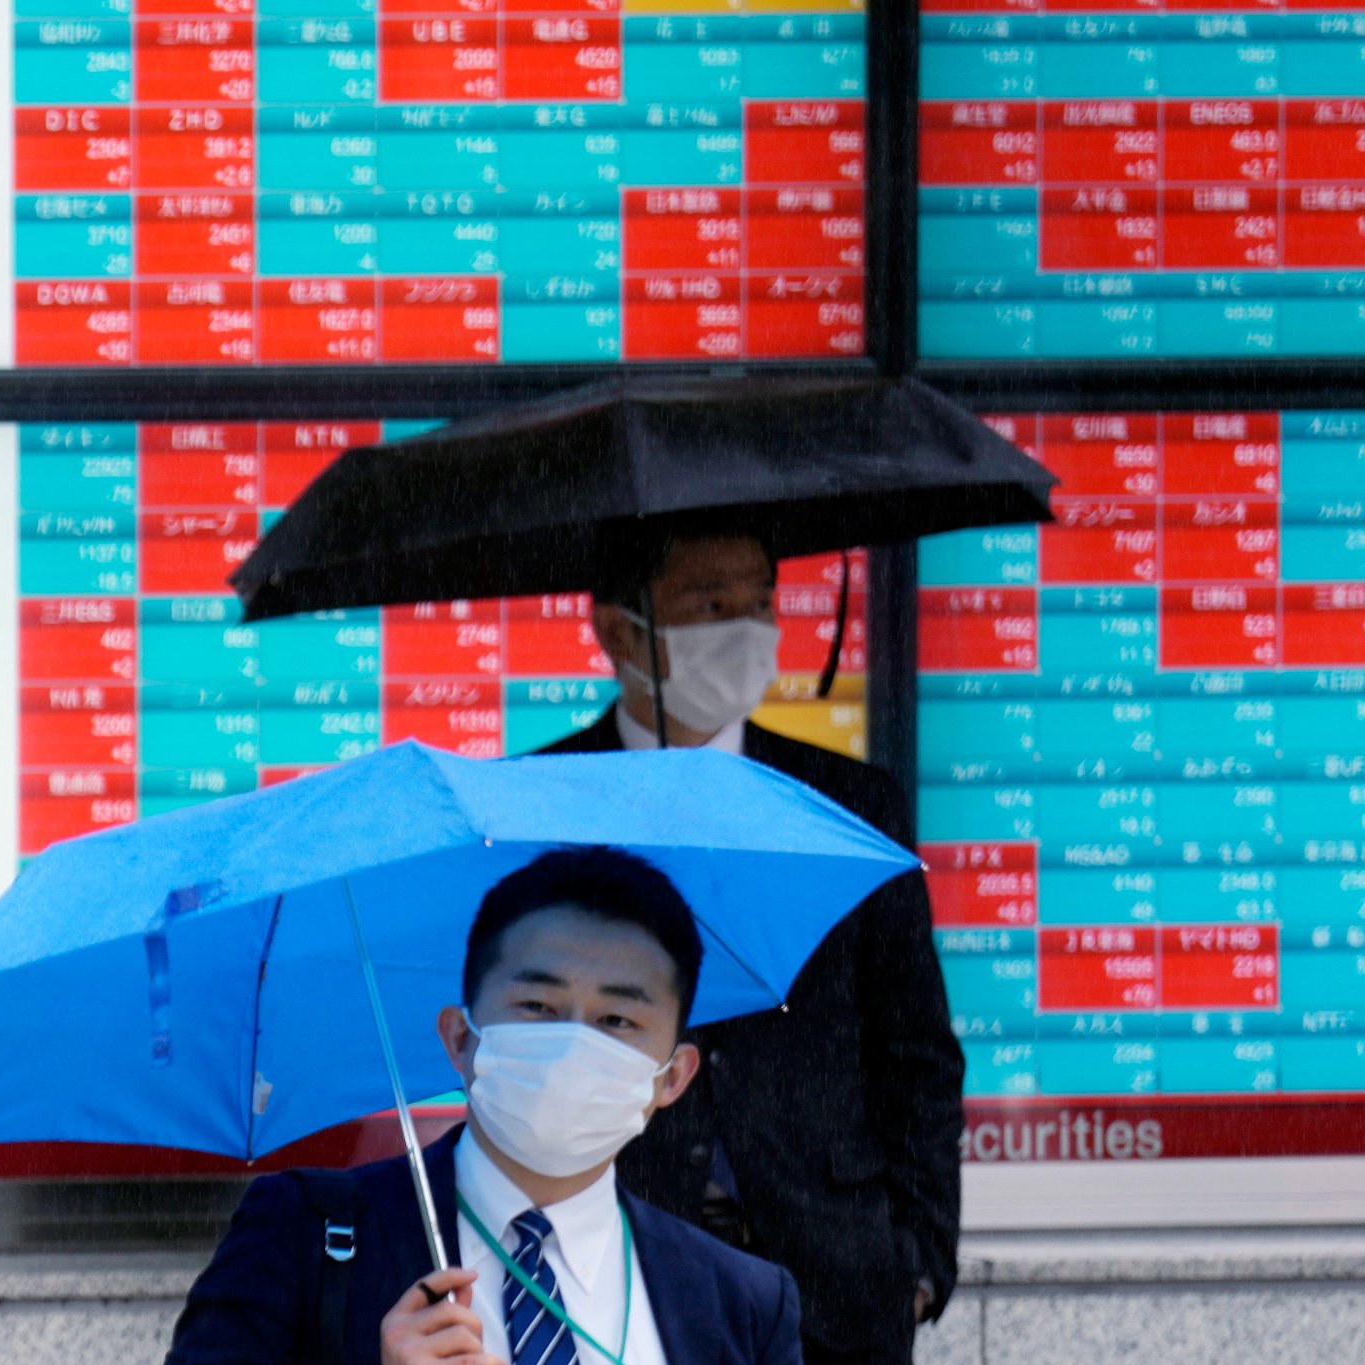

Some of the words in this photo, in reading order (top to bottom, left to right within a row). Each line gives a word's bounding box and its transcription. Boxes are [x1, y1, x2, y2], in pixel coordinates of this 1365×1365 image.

[413, 21, 464, 42] UBE
[46, 109, 97, 131] DIC
[169, 109, 221, 130] ZHD
[1190, 103, 1252, 124] ENEOS
[407, 193, 473, 214] TOTO
[37, 284, 107, 305] DOWA
[296, 427, 347, 446] NTN
[528, 681, 598, 703] HOYA
[953, 846, 1003, 869] JPX
[958, 1108, 1163, 1160] curities
